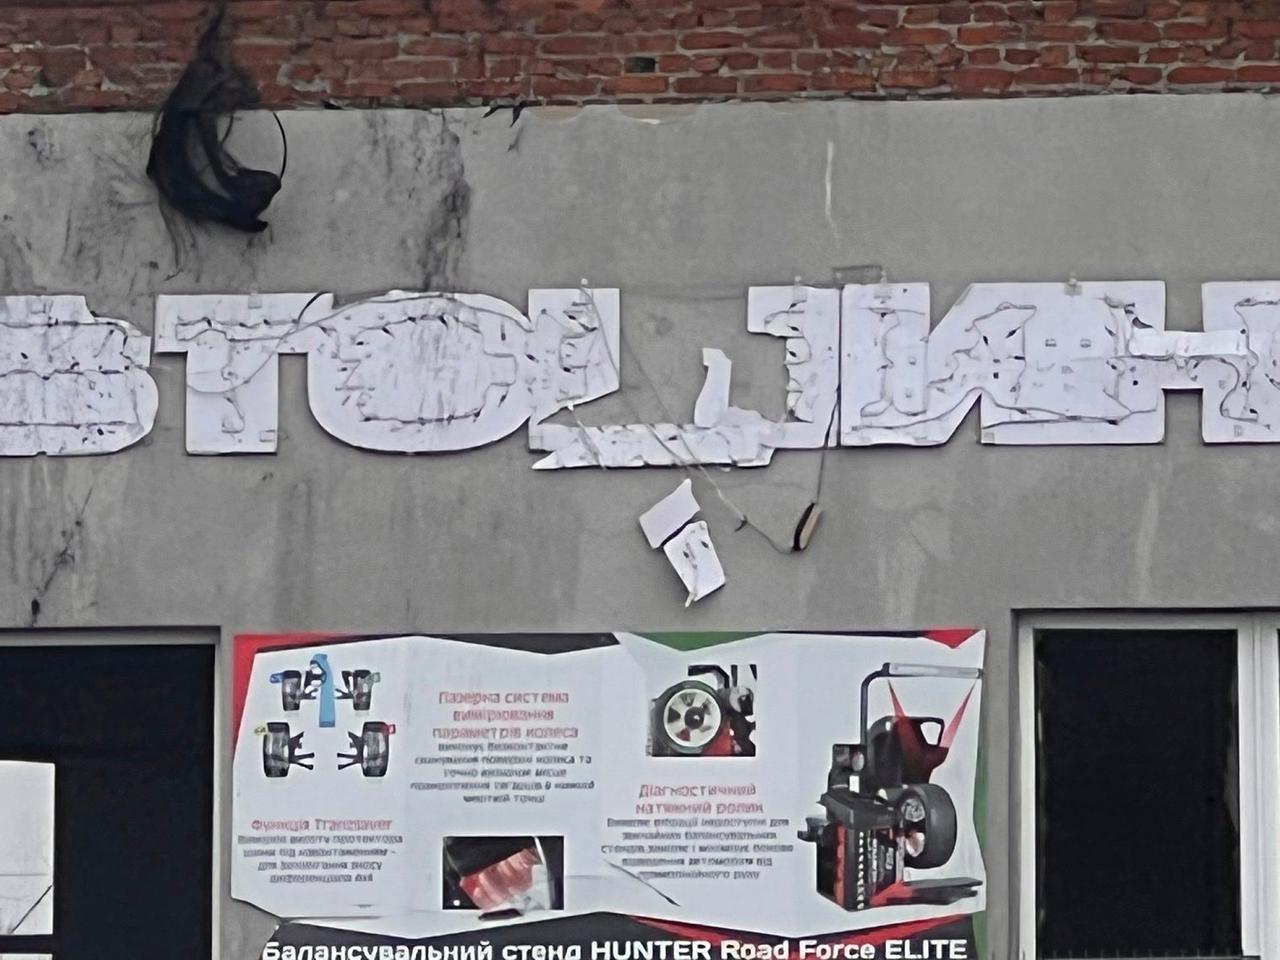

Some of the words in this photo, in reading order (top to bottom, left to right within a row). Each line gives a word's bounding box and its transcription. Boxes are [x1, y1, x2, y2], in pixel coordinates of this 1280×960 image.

[262, 940, 493, 960] Балансувальний
[501, 944, 581, 960] стенд
[591, 939, 711, 960] HUNTER
[721, 939, 790, 960] Road
[800, 939, 875, 960] Force
[885, 939, 967, 960] ELITE
